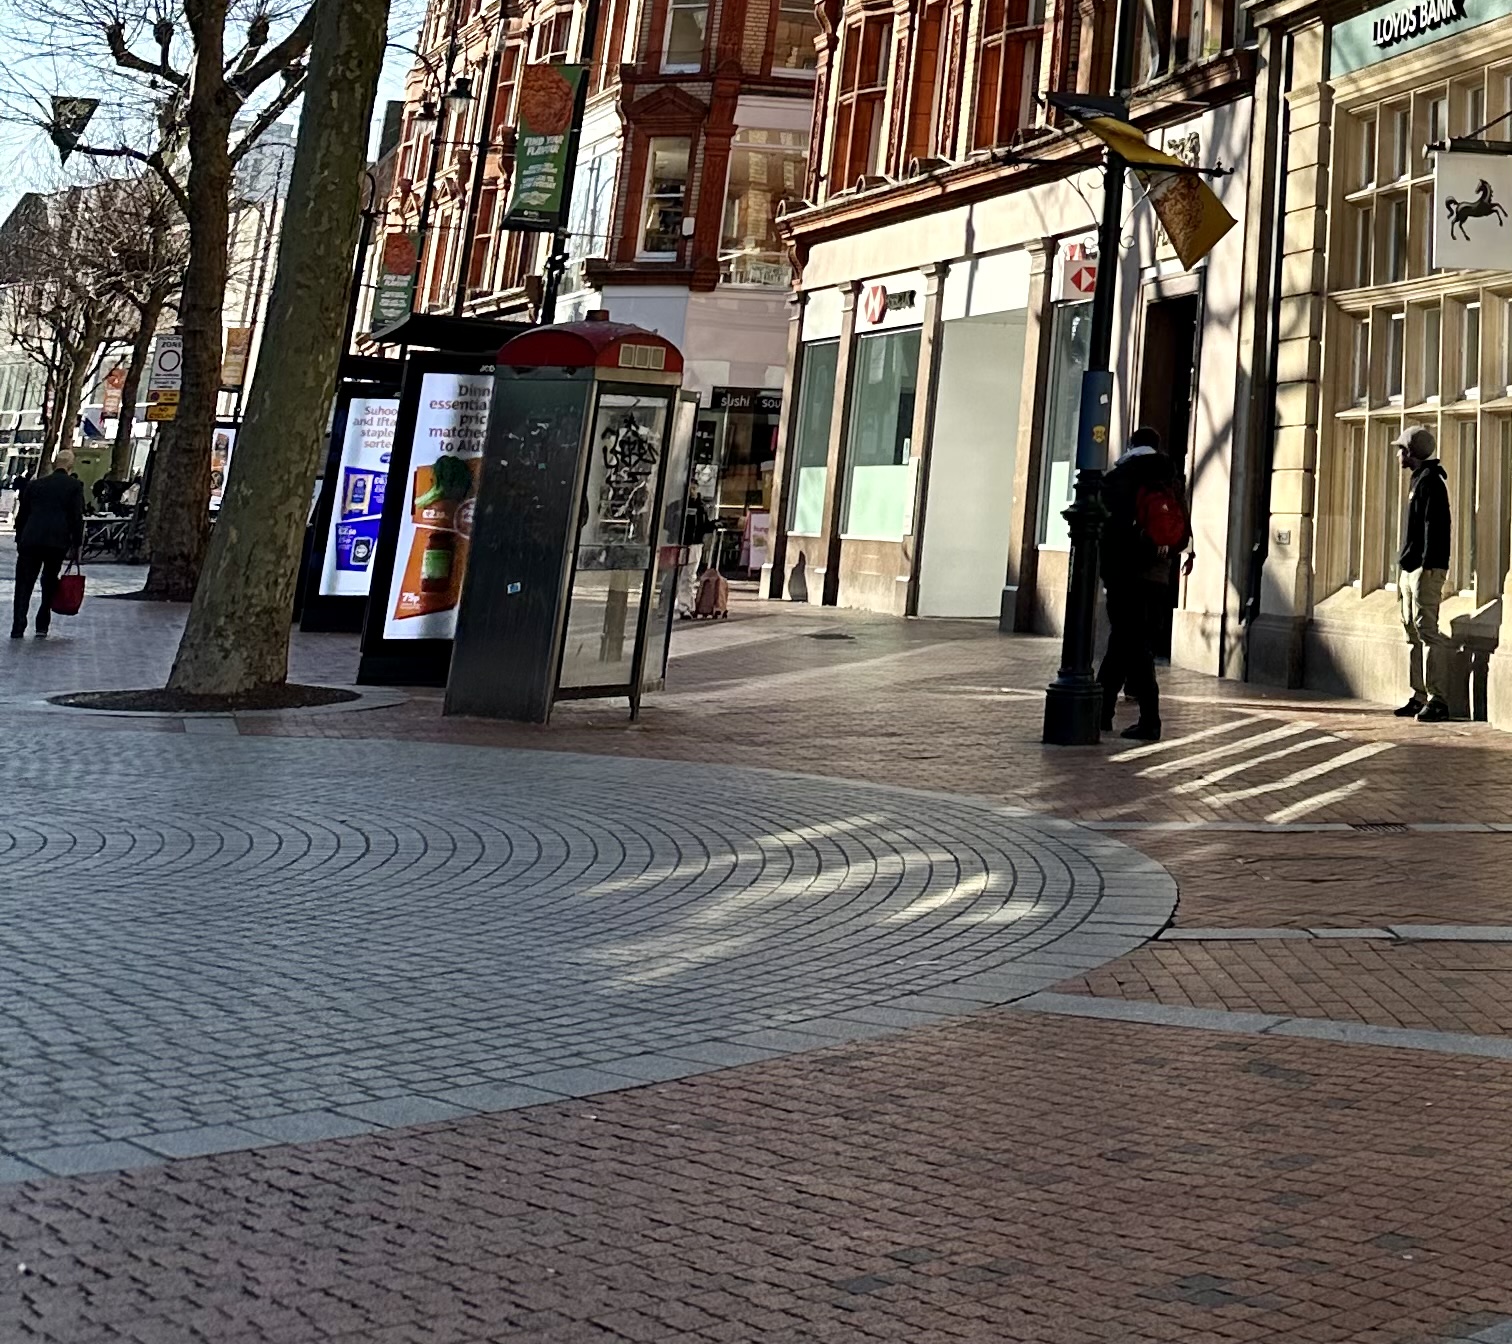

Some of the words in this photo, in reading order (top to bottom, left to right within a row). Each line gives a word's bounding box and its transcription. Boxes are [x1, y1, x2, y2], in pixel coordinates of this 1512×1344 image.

[1373, 5, 1418, 47] LLOYDS
[721, 394, 751, 407] sushi
[353, 417, 374, 426] and
[440, 440, 454, 452] to
